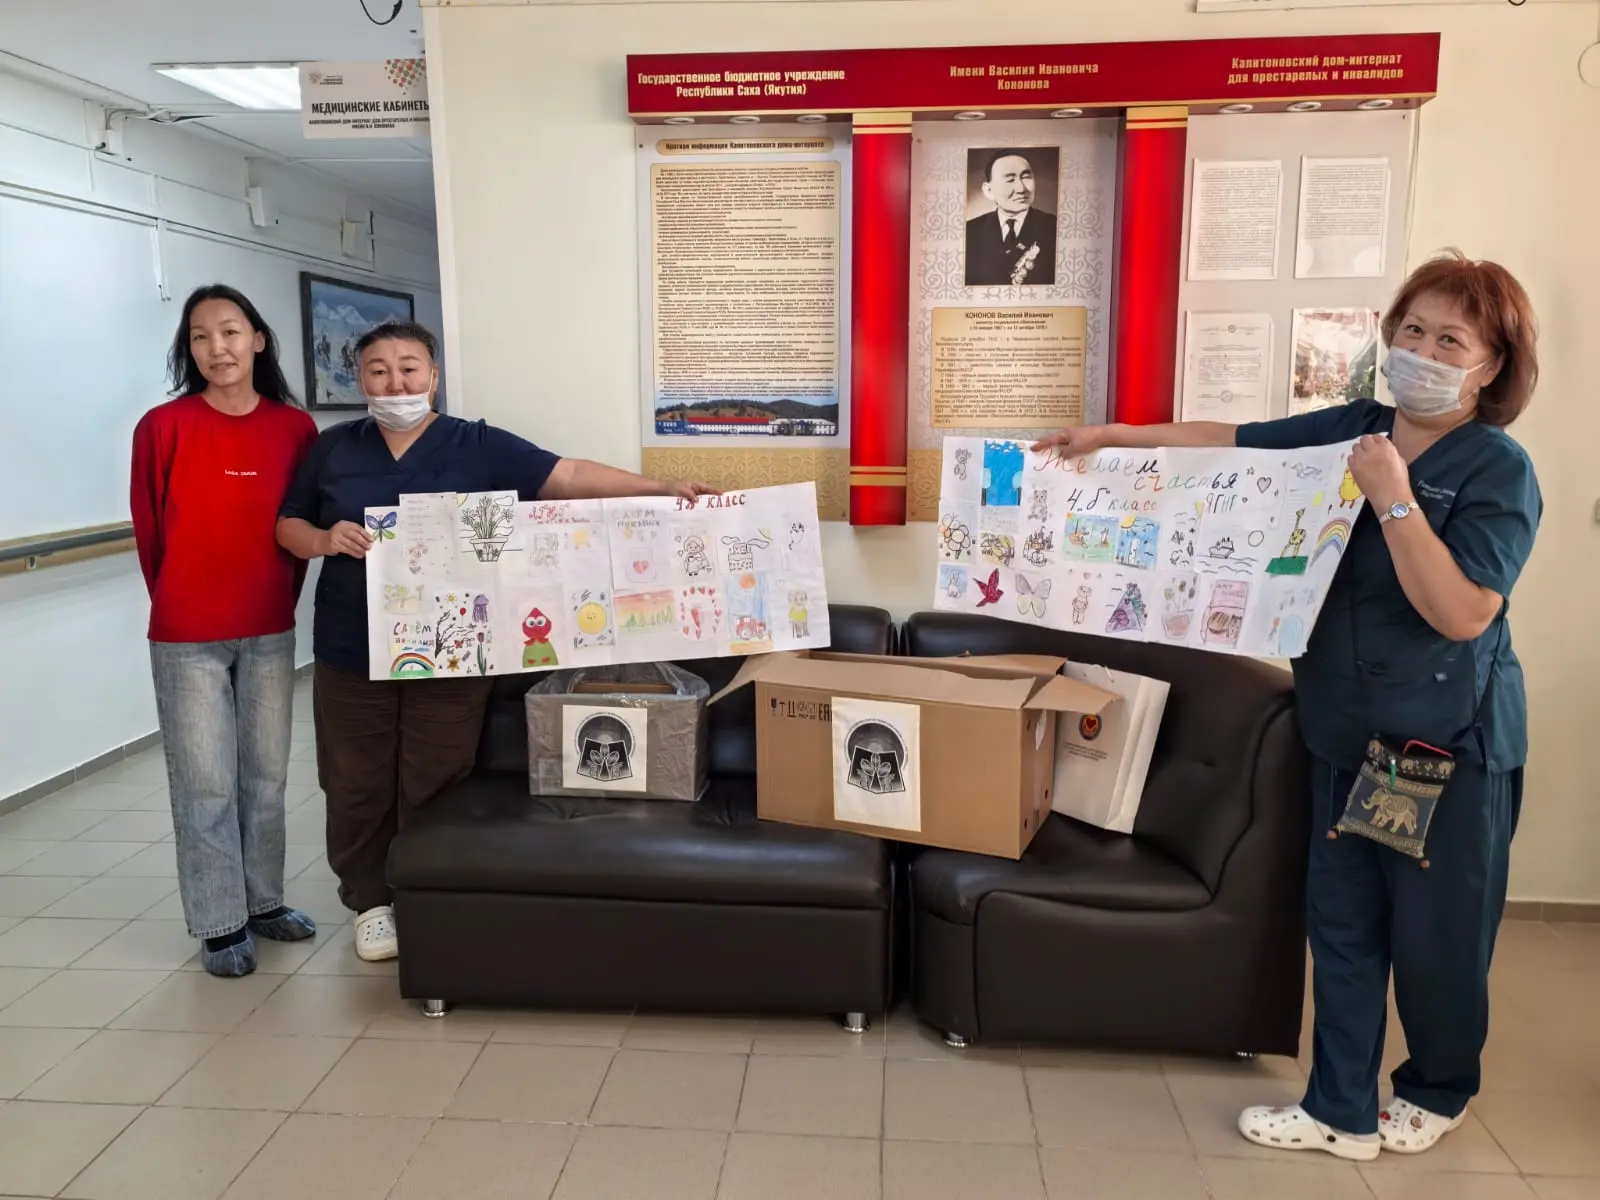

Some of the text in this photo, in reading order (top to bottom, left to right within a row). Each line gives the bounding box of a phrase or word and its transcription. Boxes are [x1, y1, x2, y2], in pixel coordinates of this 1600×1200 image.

[1231, 54, 1402, 69] Капитоновский дом-интернат
[637, 69, 846, 85] Государственное бюджетное учреждение
[950, 63, 1099, 77] Имени Василия Ивановича
[1227, 68, 1404, 84] для престарелых и инвалидов
[676, 83, 807, 98] Республики Саха (Якутия)
[997, 79, 1050, 90] Кононова
[311, 101, 381, 115] МЕДИЦИНСКИЕ
[665, 142, 690, 151] Краткая
[691, 142, 728, 151] информация
[730, 140, 777, 150] Капитоновского
[997, 311, 1022, 319] Василий
[1023, 311, 1054, 319] Иванович
[1134, 473, 1239, 492] счастья
